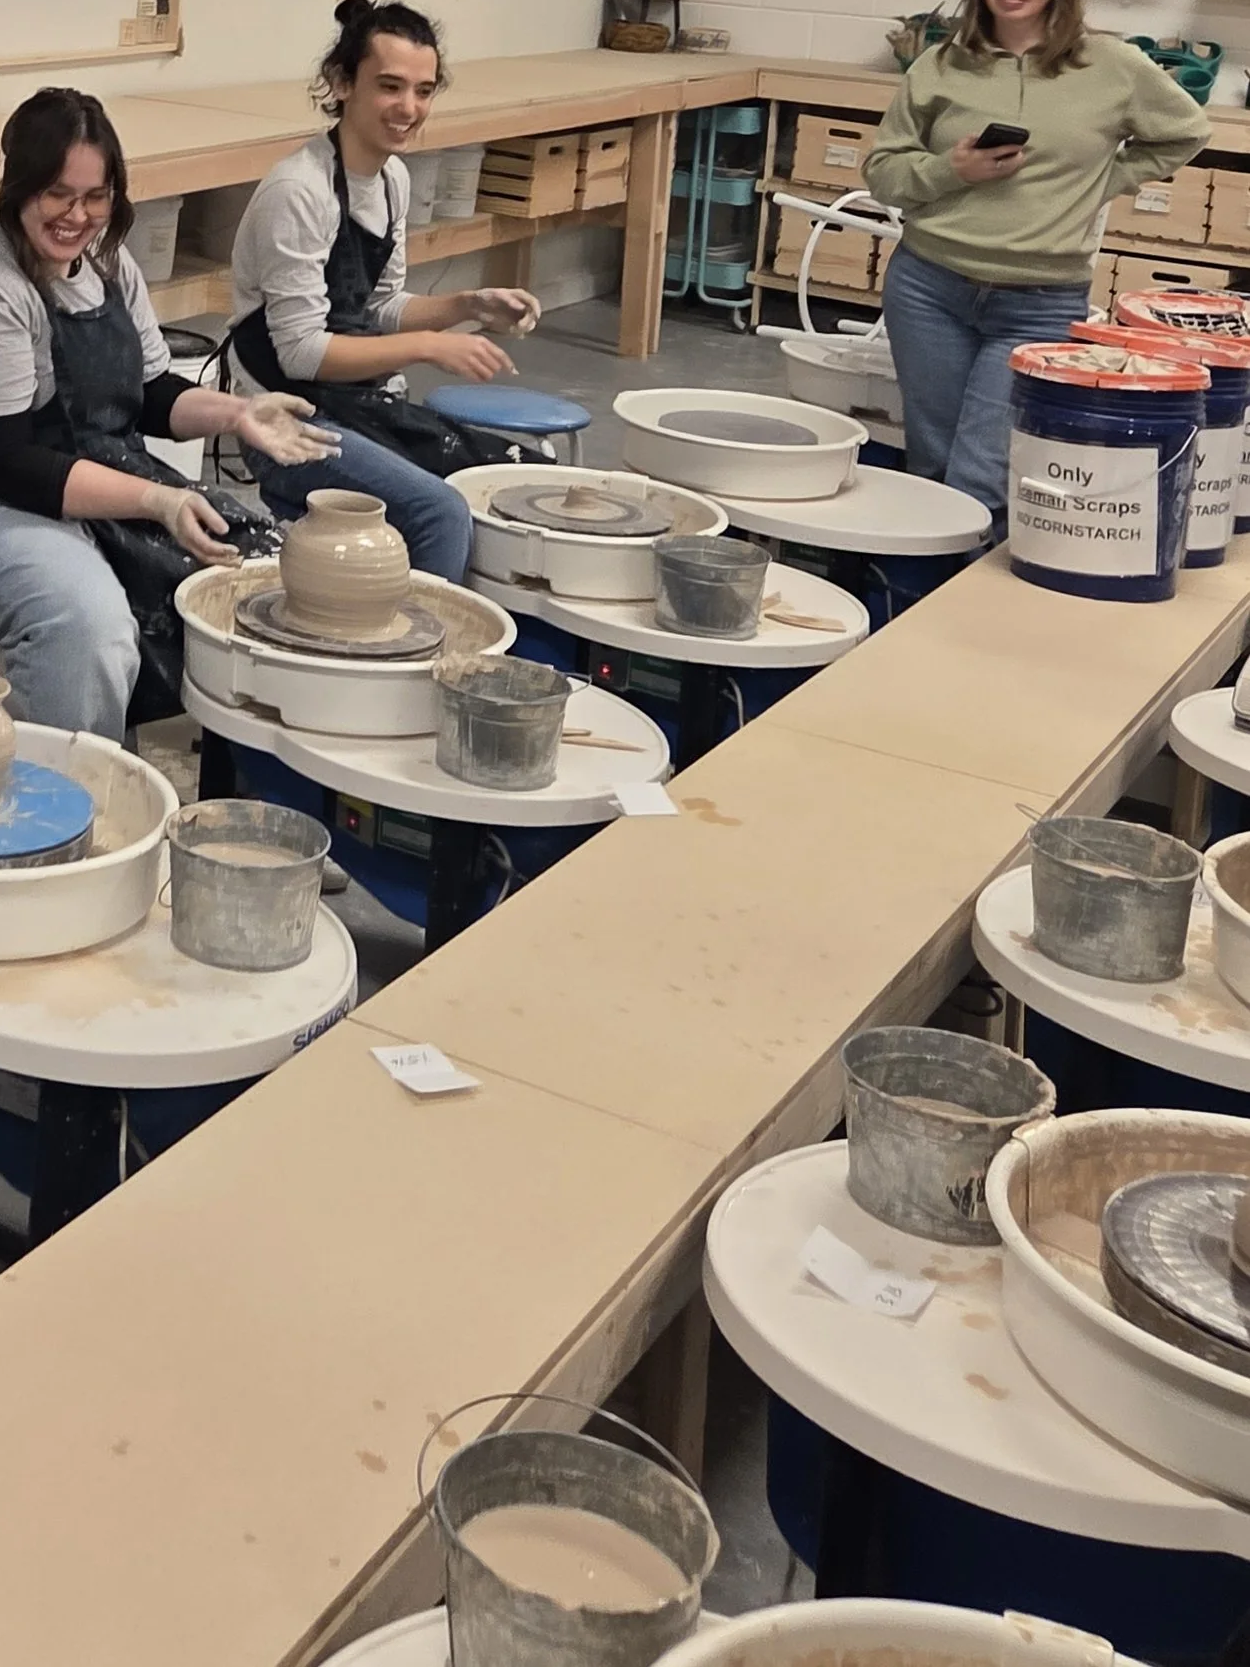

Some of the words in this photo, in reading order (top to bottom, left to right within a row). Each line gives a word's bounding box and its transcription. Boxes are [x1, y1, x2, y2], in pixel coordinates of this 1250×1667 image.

[1047, 461, 1093, 487] Only
[1073, 495, 1142, 518] Scraps
[1033, 516, 1142, 541] CORNSTARCH
